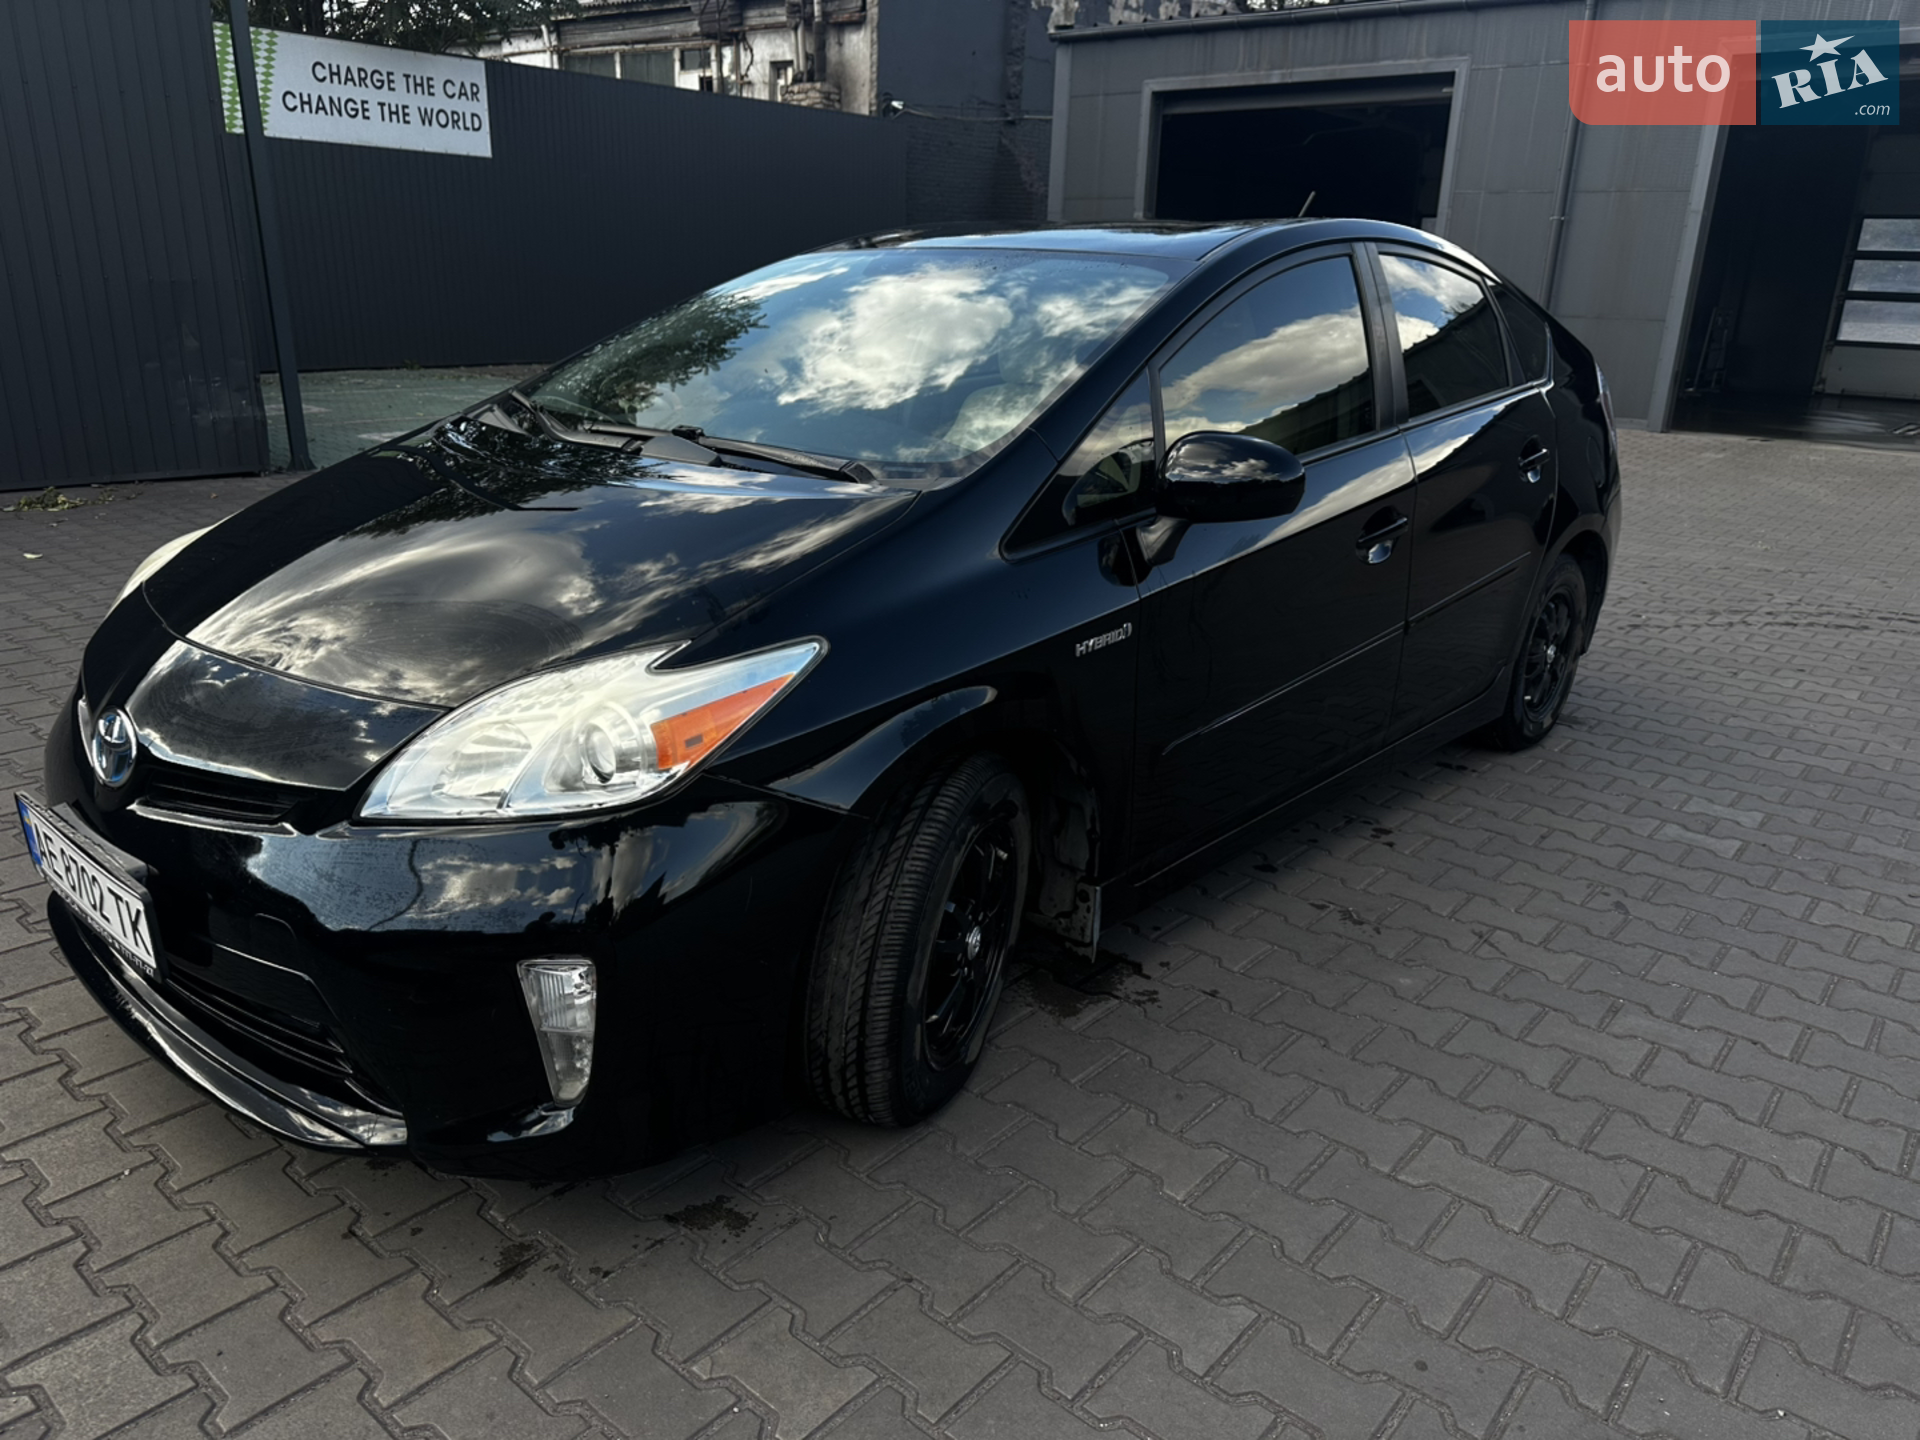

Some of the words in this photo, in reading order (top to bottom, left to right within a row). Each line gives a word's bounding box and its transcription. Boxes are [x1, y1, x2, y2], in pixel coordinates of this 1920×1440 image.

[311, 61, 396, 92] CHARGE
[402, 73, 436, 97] THE
[442, 79, 481, 103] CAR
[281, 90, 371, 121] CHANGE
[377, 101, 412, 125] THE
[417, 106, 482, 132] WORLD
[1075, 628, 1126, 657] HYBRID
[34, 822, 64, 882] AE
[60, 847, 111, 925] 8702
[107, 885, 153, 959] TK
